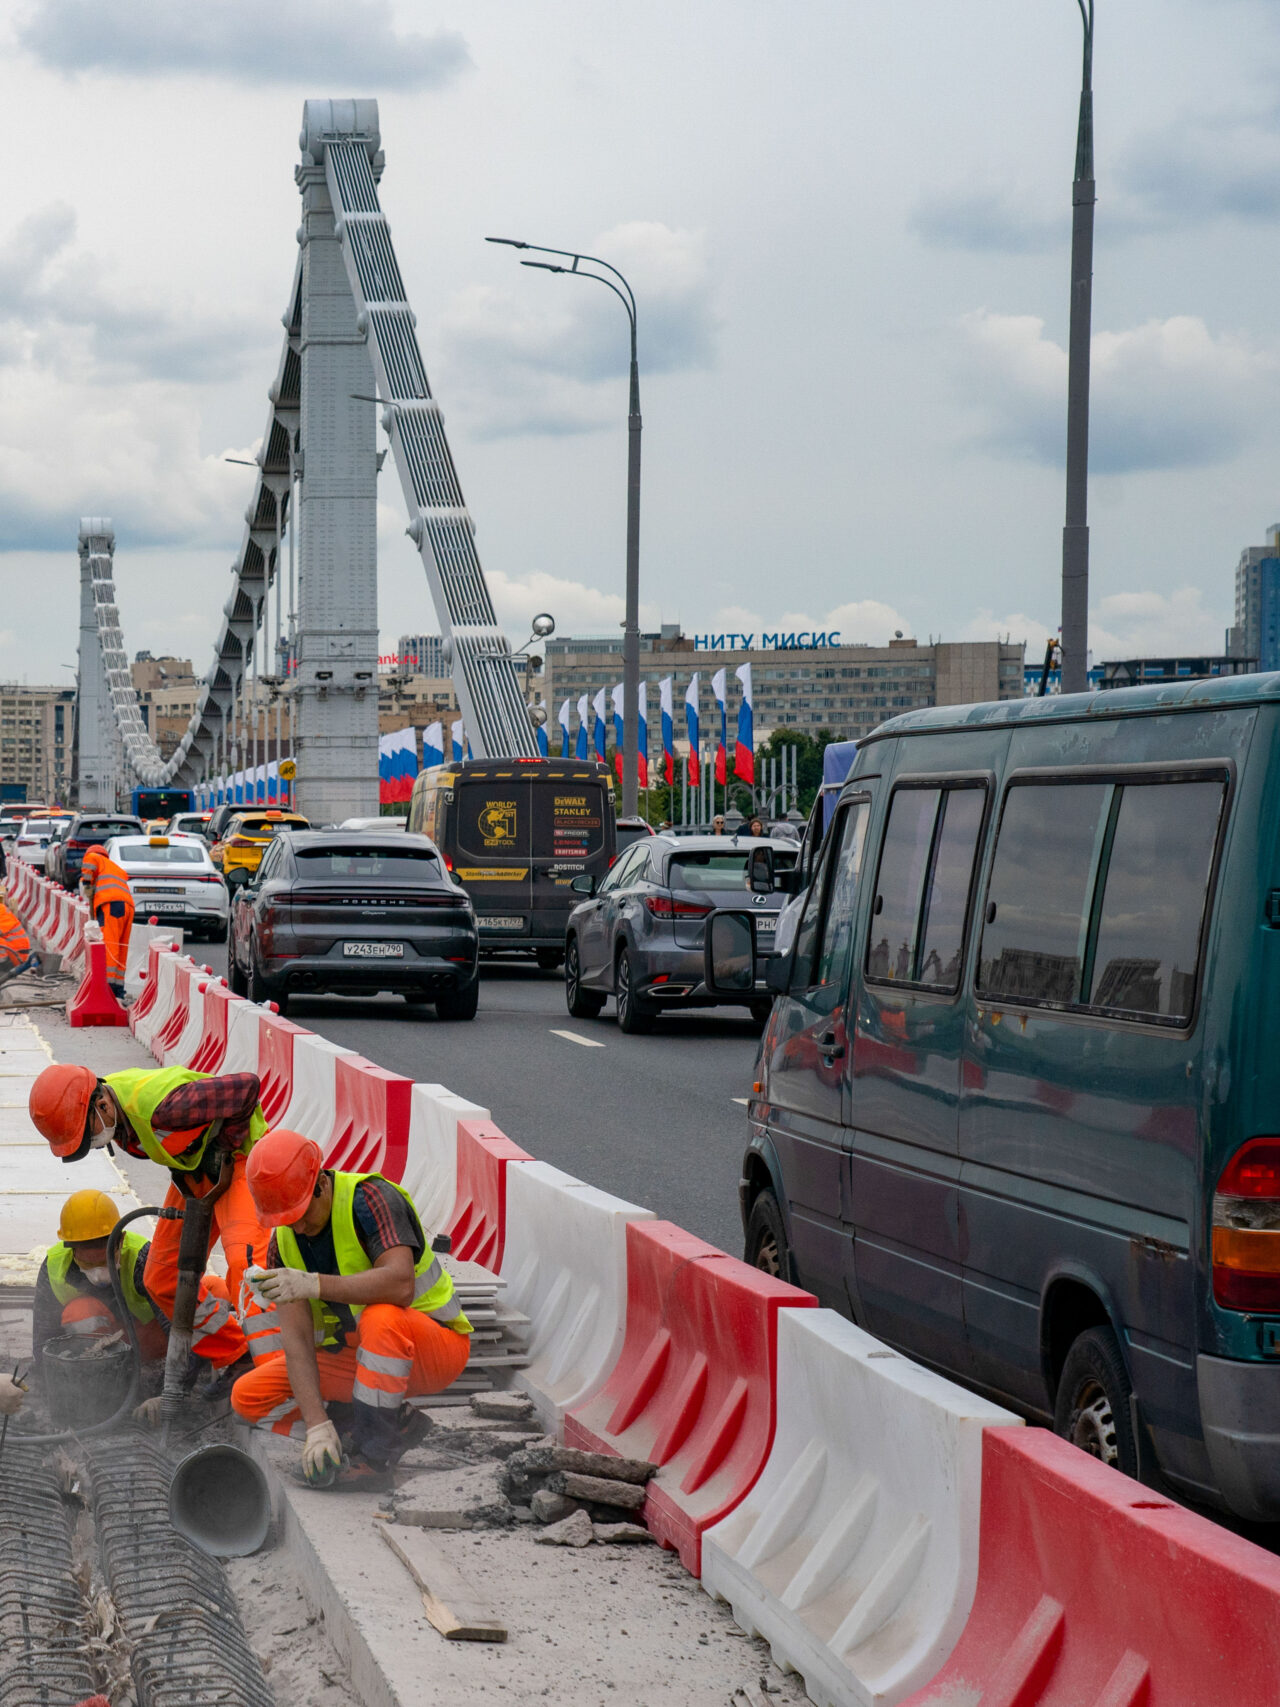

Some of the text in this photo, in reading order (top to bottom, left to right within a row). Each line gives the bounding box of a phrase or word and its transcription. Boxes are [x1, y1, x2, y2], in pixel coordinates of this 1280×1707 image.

[694, 631, 841, 650] НИТУ МИСИС
[377, 652, 419, 665] ank.ru
